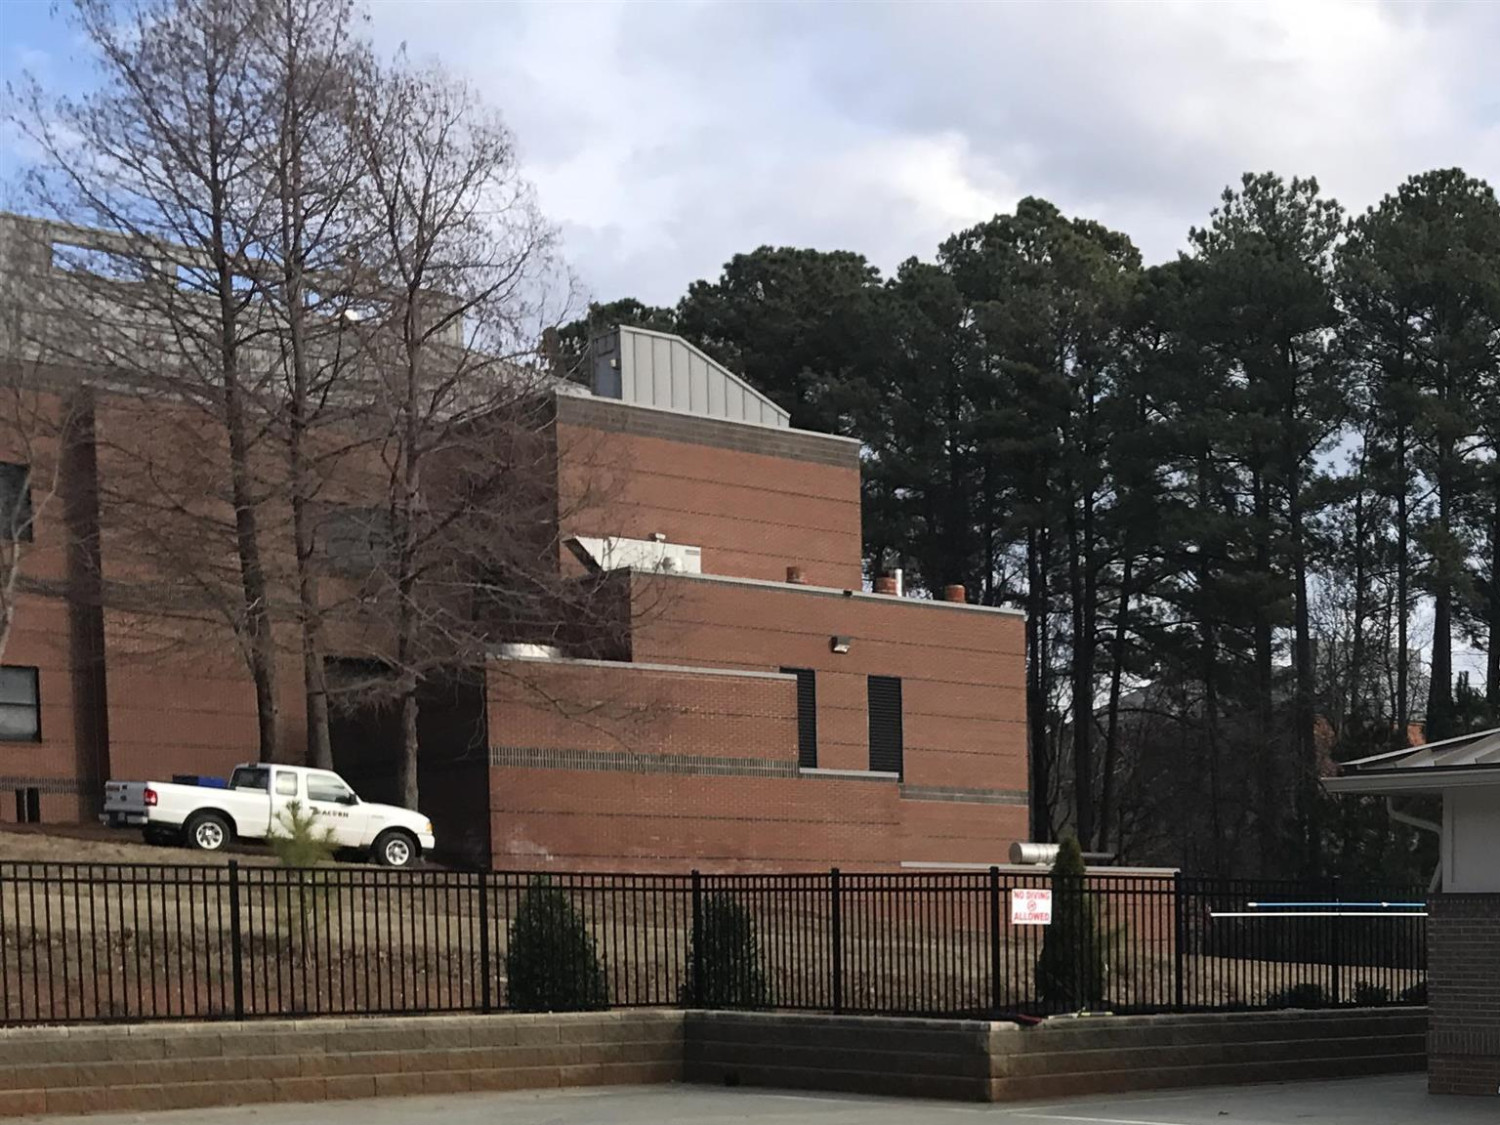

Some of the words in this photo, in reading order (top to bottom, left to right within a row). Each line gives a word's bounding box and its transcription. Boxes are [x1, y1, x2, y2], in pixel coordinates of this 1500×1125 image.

[1014, 891, 1024, 899] NO
[1026, 891, 1050, 900] DIVING
[1014, 912, 1049, 921] ALLOWED
